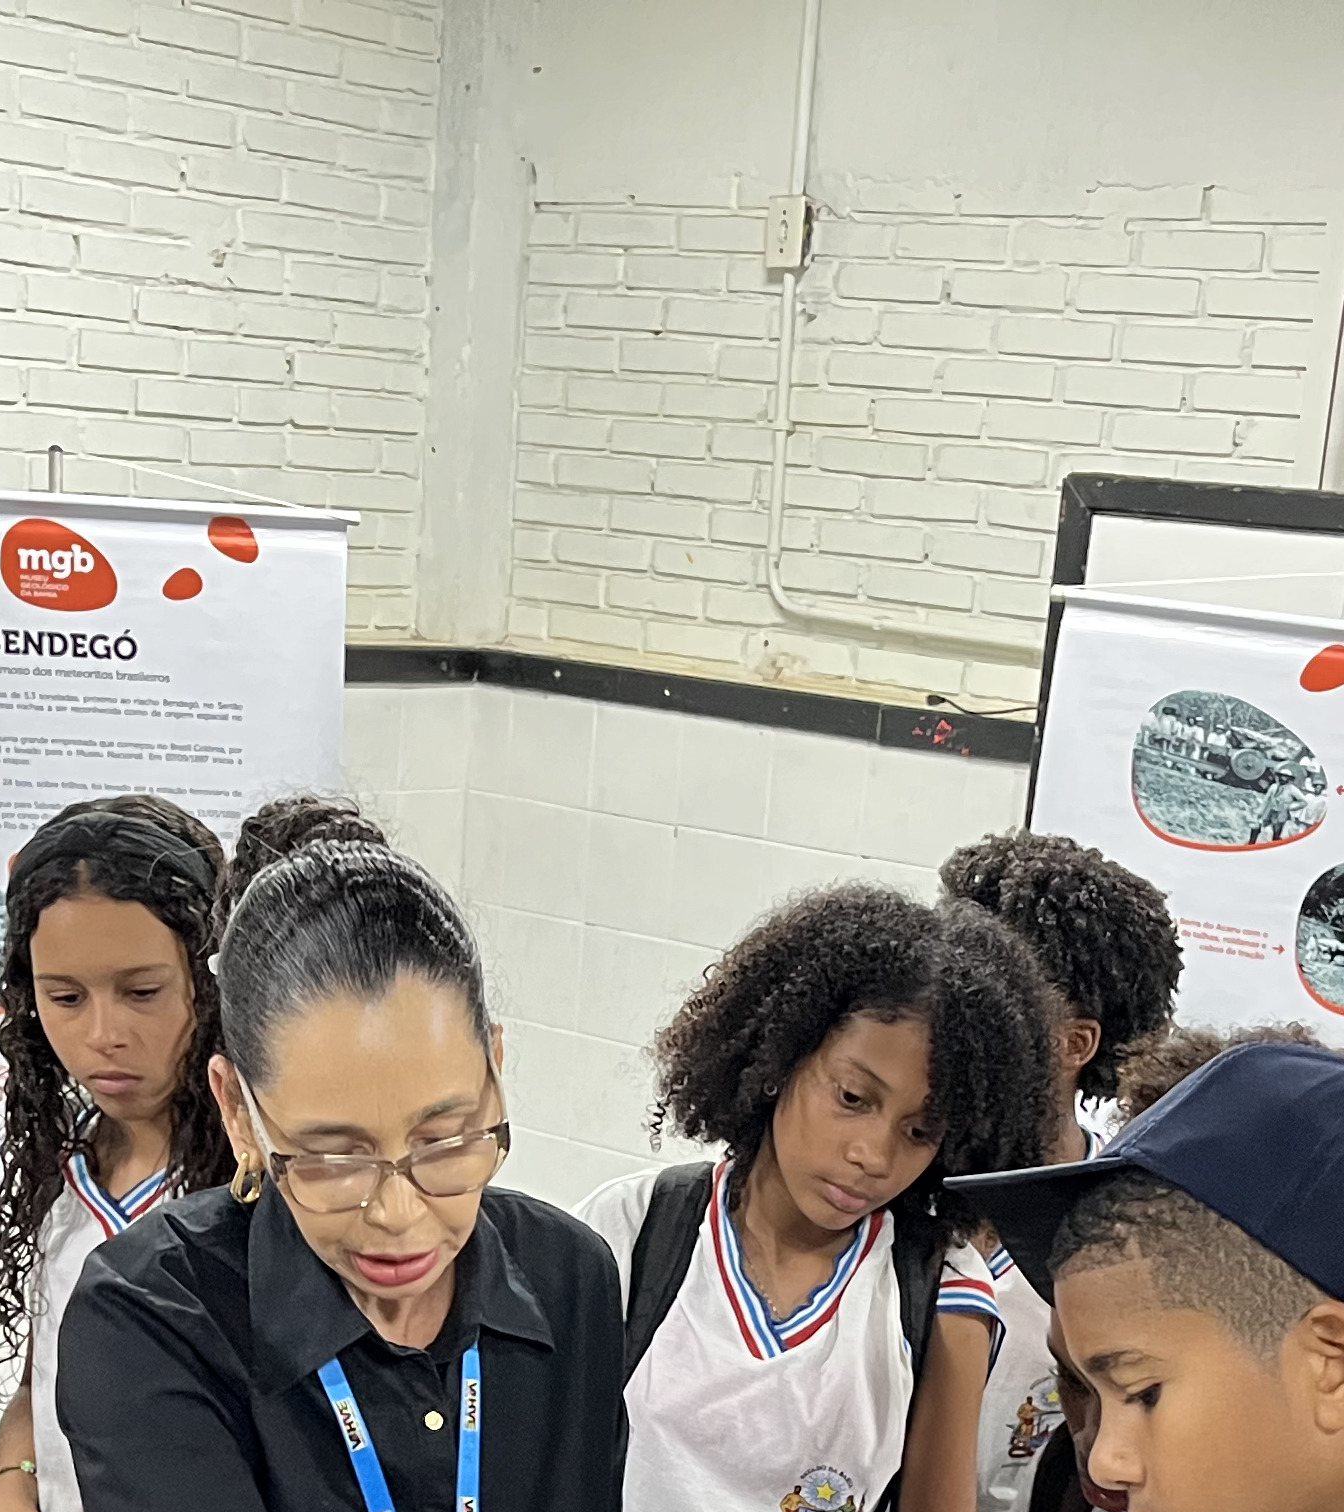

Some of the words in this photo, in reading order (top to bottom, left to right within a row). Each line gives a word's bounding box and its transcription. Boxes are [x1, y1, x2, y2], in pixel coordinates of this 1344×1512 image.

[17, 544, 95, 579] mgb
[32, 666, 53, 677] dos
[55, 669, 114, 680] meteoritos
[115, 670, 171, 684] brasileiros
